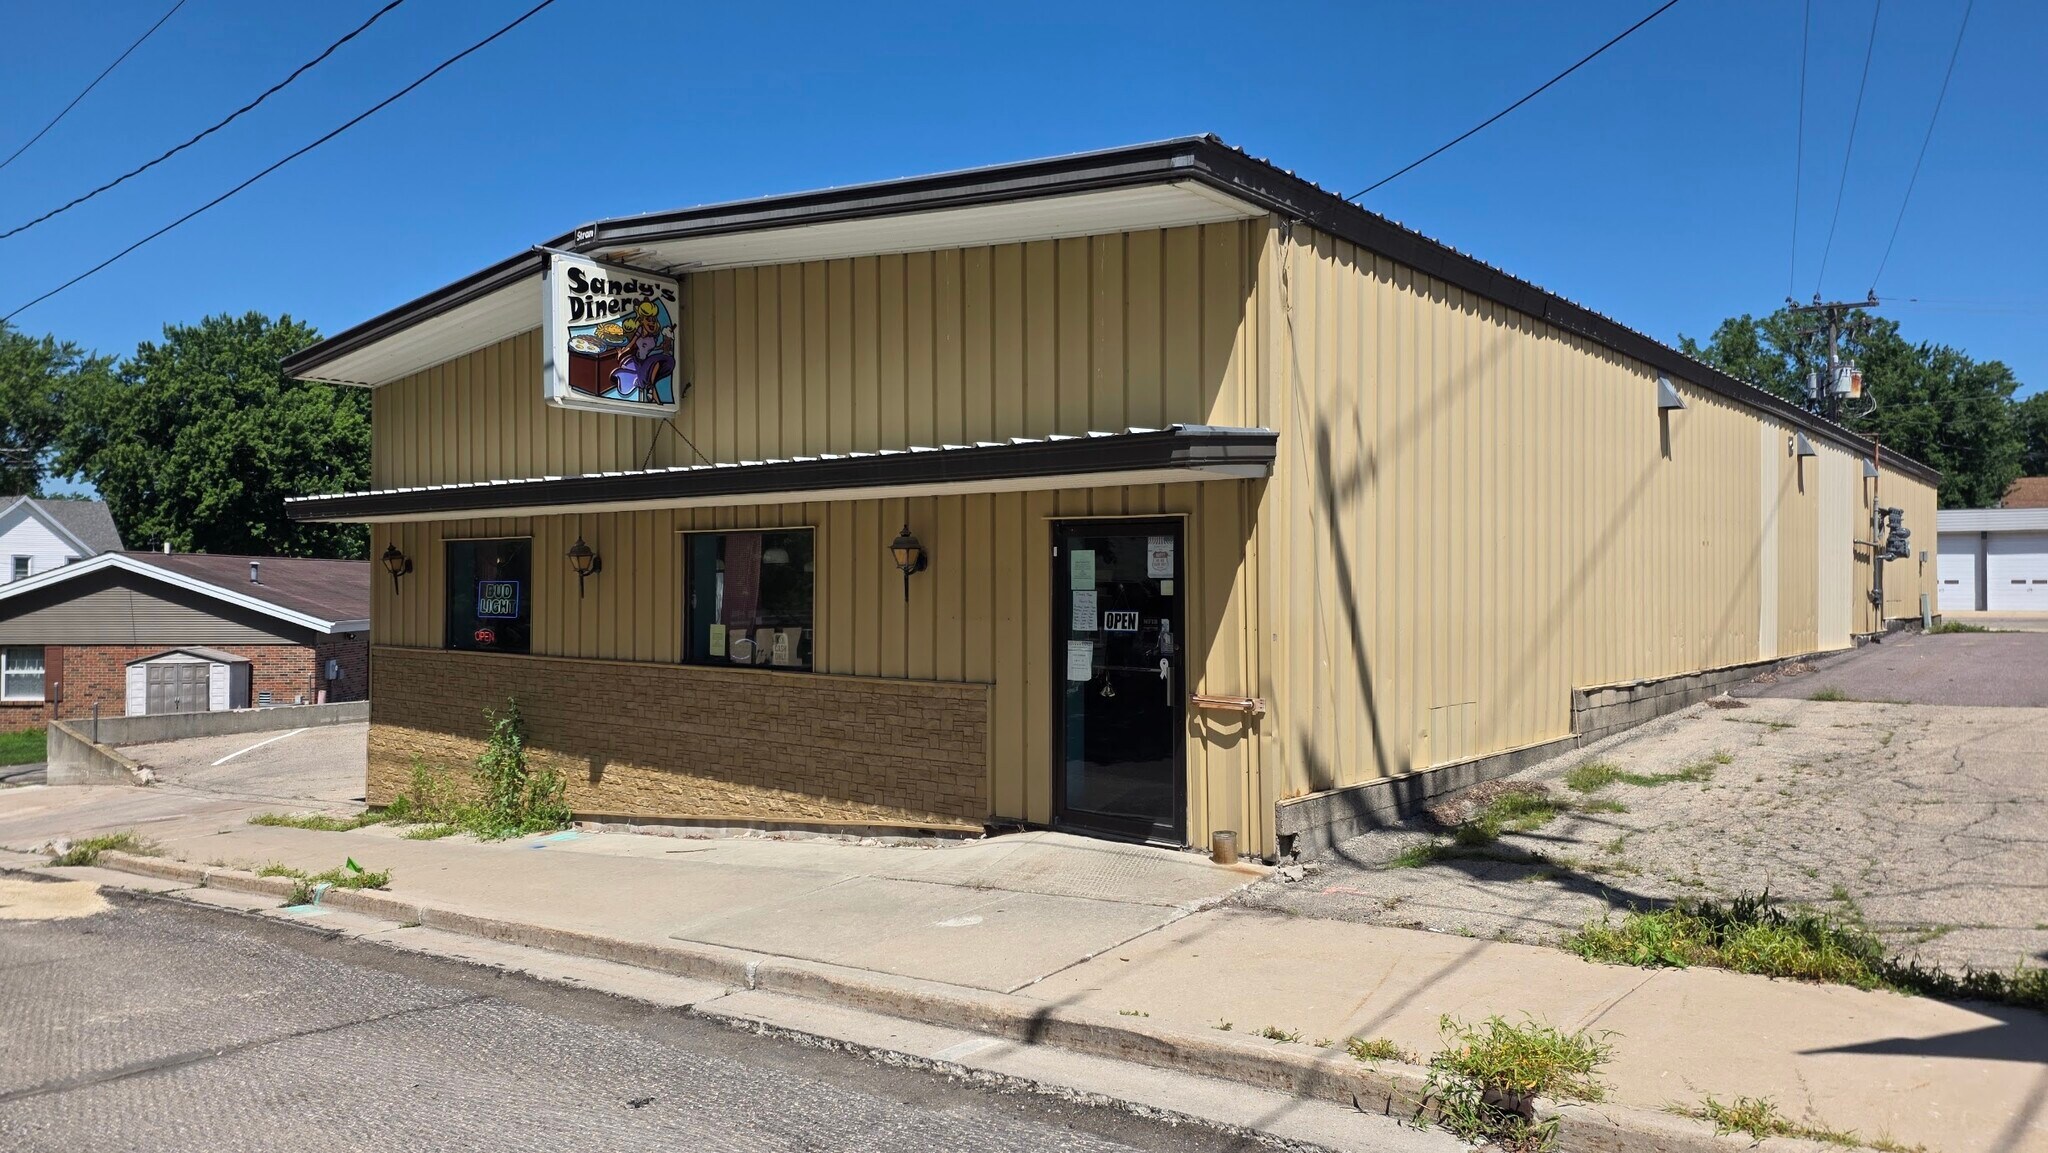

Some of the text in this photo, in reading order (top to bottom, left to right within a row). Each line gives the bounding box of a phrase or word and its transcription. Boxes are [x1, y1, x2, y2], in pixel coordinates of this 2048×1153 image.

[567, 266, 676, 302] Sandy's
[567, 294, 632, 323] Diner
[486, 583, 513, 599] BUD
[480, 598, 517, 615] LIGHT
[1106, 612, 1137, 630] OPEN
[474, 630, 495, 642] OPEN
